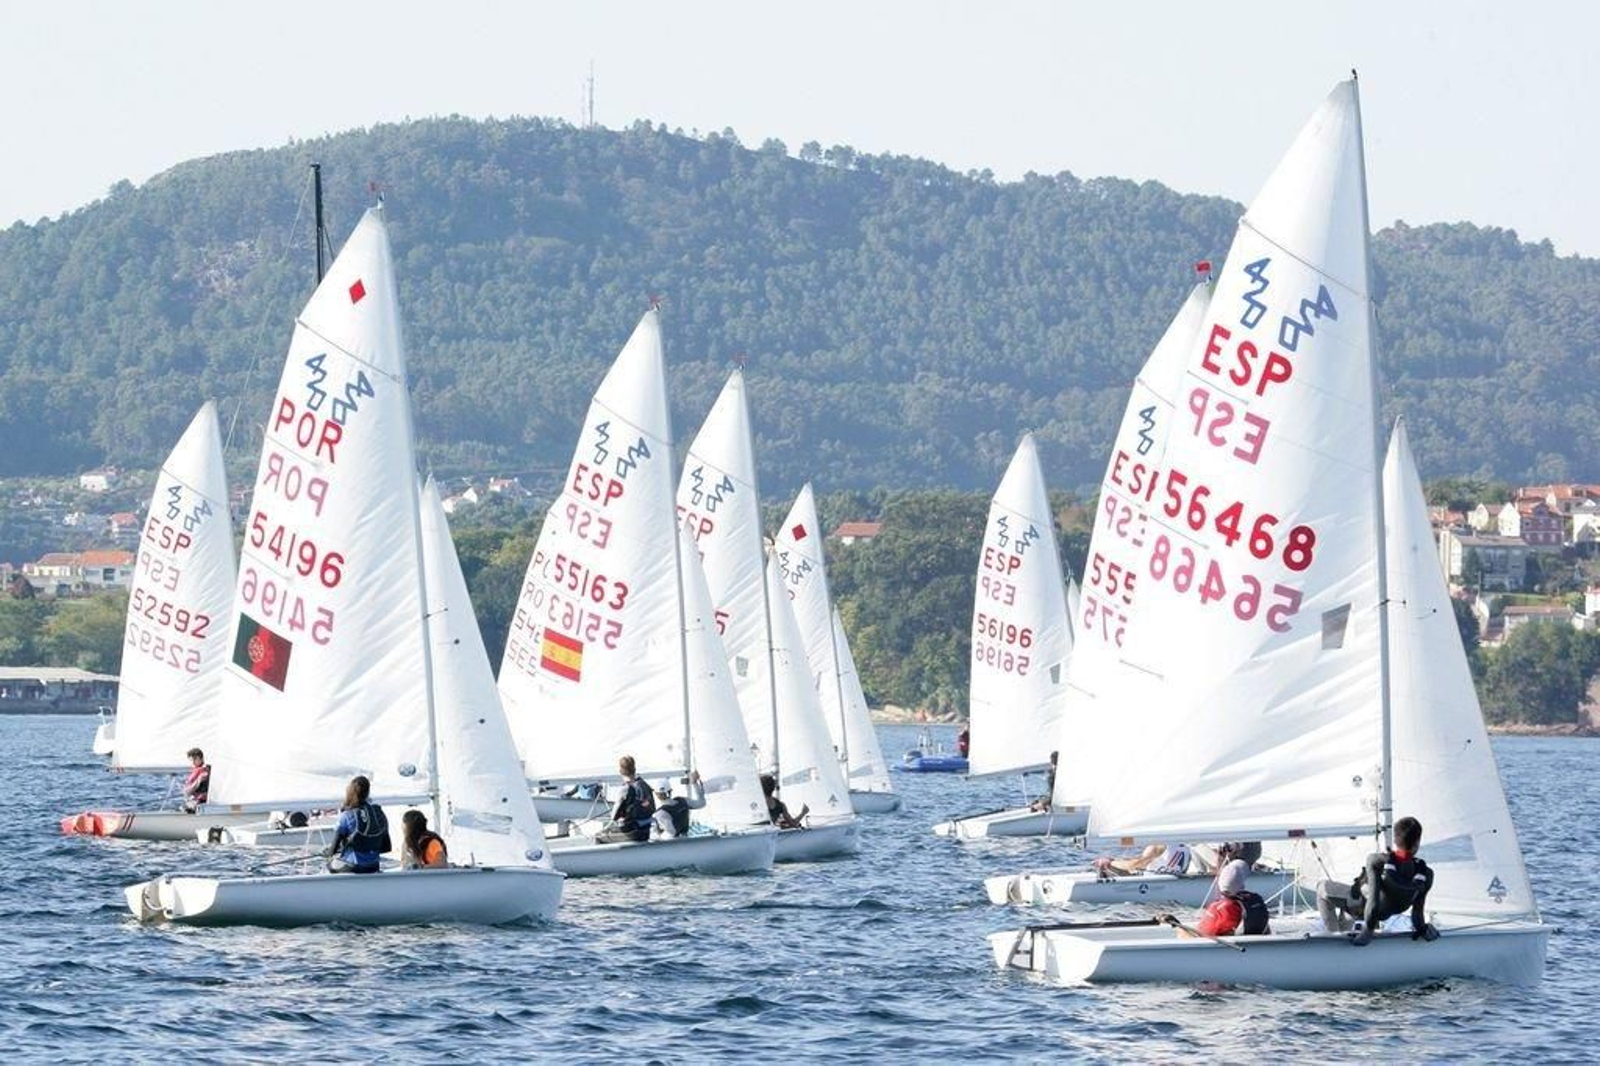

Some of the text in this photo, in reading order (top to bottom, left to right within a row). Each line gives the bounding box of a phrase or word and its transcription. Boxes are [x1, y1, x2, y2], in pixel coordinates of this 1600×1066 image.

[1201, 323, 1293, 397] ESP
[274, 397, 343, 463] POR
[573, 464, 624, 506] ESP
[146, 516, 191, 557] ESP
[1163, 469, 1316, 571] 56468
[251, 511, 344, 588] 54196
[983, 547, 1021, 575] ESP
[554, 553, 629, 610] 55163
[1091, 552, 1136, 604] 555
[132, 588, 210, 639] 52592
[977, 613, 1032, 648] 56196
